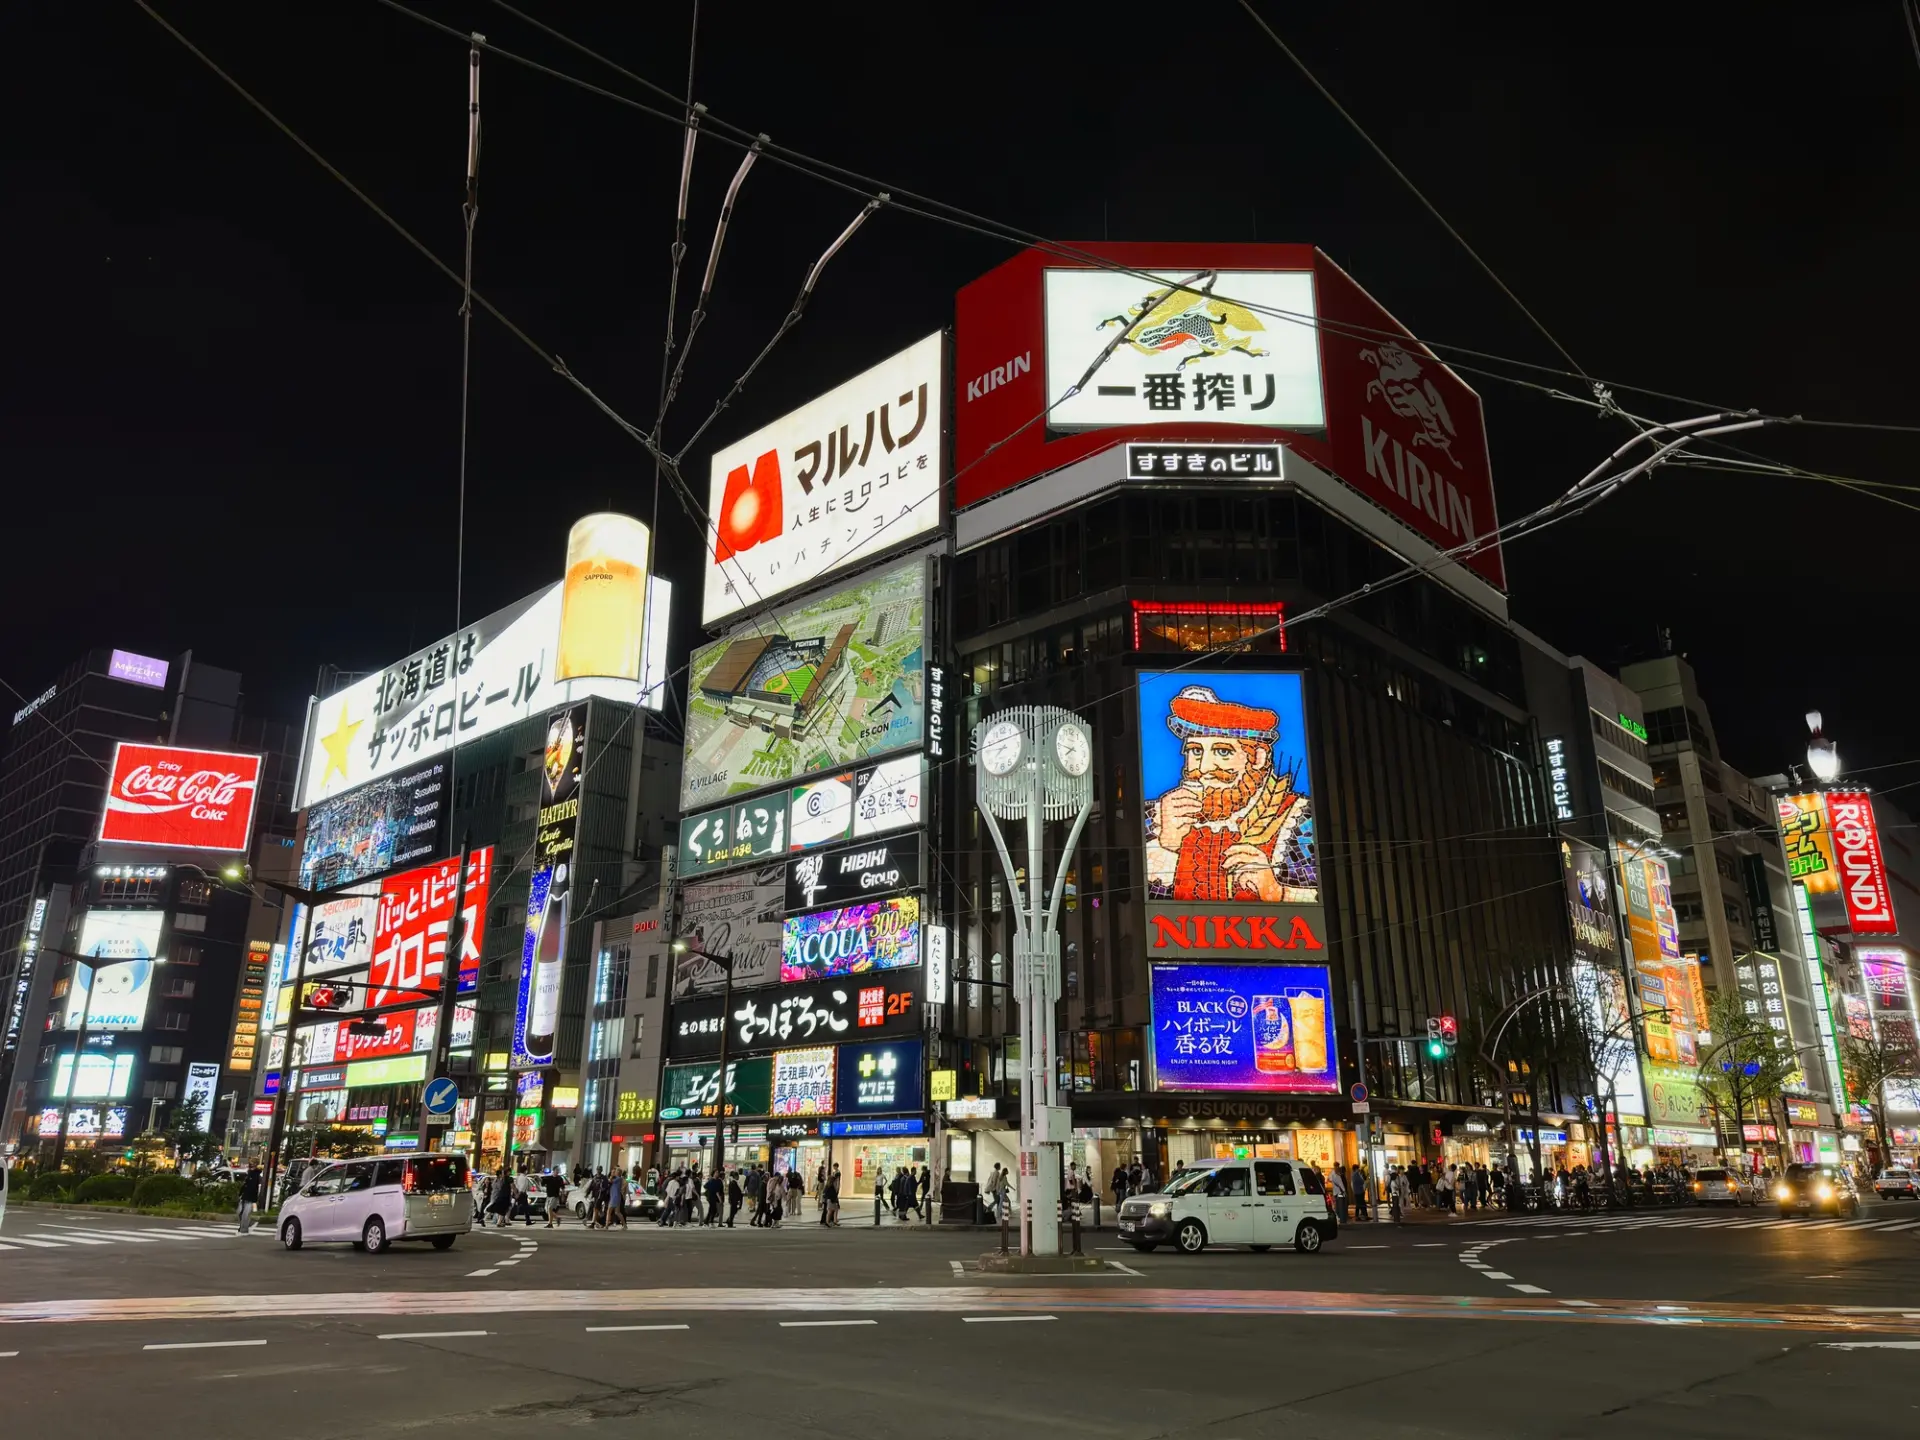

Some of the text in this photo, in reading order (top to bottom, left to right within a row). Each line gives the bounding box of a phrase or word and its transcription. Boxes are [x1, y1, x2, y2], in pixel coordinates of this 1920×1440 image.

[967, 351, 1031, 403] KIRIN
[1097, 372, 1277, 412] 一番搾り
[794, 382, 928, 496] マルハン
[1137, 451, 1273, 472] すすきのビル
[1360, 415, 1476, 544] KIRIN
[792, 453, 928, 531] 人生にヨロコビを
[724, 504, 913, 596] 新しいパチンコへ
[584, 573, 613, 582] SAPPORO
[114, 661, 162, 680] Mercure
[374, 632, 477, 718] 北海道は
[13, 697, 40, 726] Mercure
[368, 661, 543, 771] サッポロビール
[931, 666, 944, 757] すすきのビル
[860, 728, 871, 739] ES
[871, 723, 890, 736] CON
[157, 760, 183, 772] Enjoy
[401, 764, 444, 787] Experience the
[121, 764, 241, 806] Coca-Cola
[858, 773, 870, 786] 2F
[1546, 738, 1572, 820] すすきのビル
[414, 783, 441, 799] Susukino
[190, 804, 228, 821] Coke
[414, 801, 439, 817] Sapporo
[539, 799, 578, 825] HATHYR
[409, 819, 436, 835] Hokkaido
[688, 806, 771, 858] くろねこ
[546, 837, 574, 854] Capella
[707, 843, 752, 864] Lounge
[1860, 804, 1888, 907] SPORTS ENTERTAINMENT
[840, 848, 887, 874] HIBIKI
[1832, 803, 1891, 923] ROUND1
[795, 854, 827, 907] 響
[860, 869, 899, 889] Group
[1631, 889, 1649, 909] CLUB
[307, 914, 368, 965] 長次郎
[1150, 914, 1324, 950] NIKKA
[374, 905, 480, 1007] プロミス
[789, 927, 870, 967] ACQUA
[887, 992, 911, 1016] 2F
[1177, 1000, 1226, 1014] BLACK
[86, 1015, 139, 1024] DAIKIN
[734, 989, 849, 1044] さっぽろっこ
[1162, 1017, 1242, 1034] ハイボール
[1174, 1034, 1234, 1055] 香る夜
[777, 1064, 827, 1082] 元祖串かつ
[858, 1080, 896, 1096] サツドラ
[1178, 1102, 1316, 1118] SUSUKINO BLD.
[853, 1122, 909, 1132] HOKKAIDO HAPPY LIFESTYLE
[1540, 1132, 1558, 1141] LAWSON
